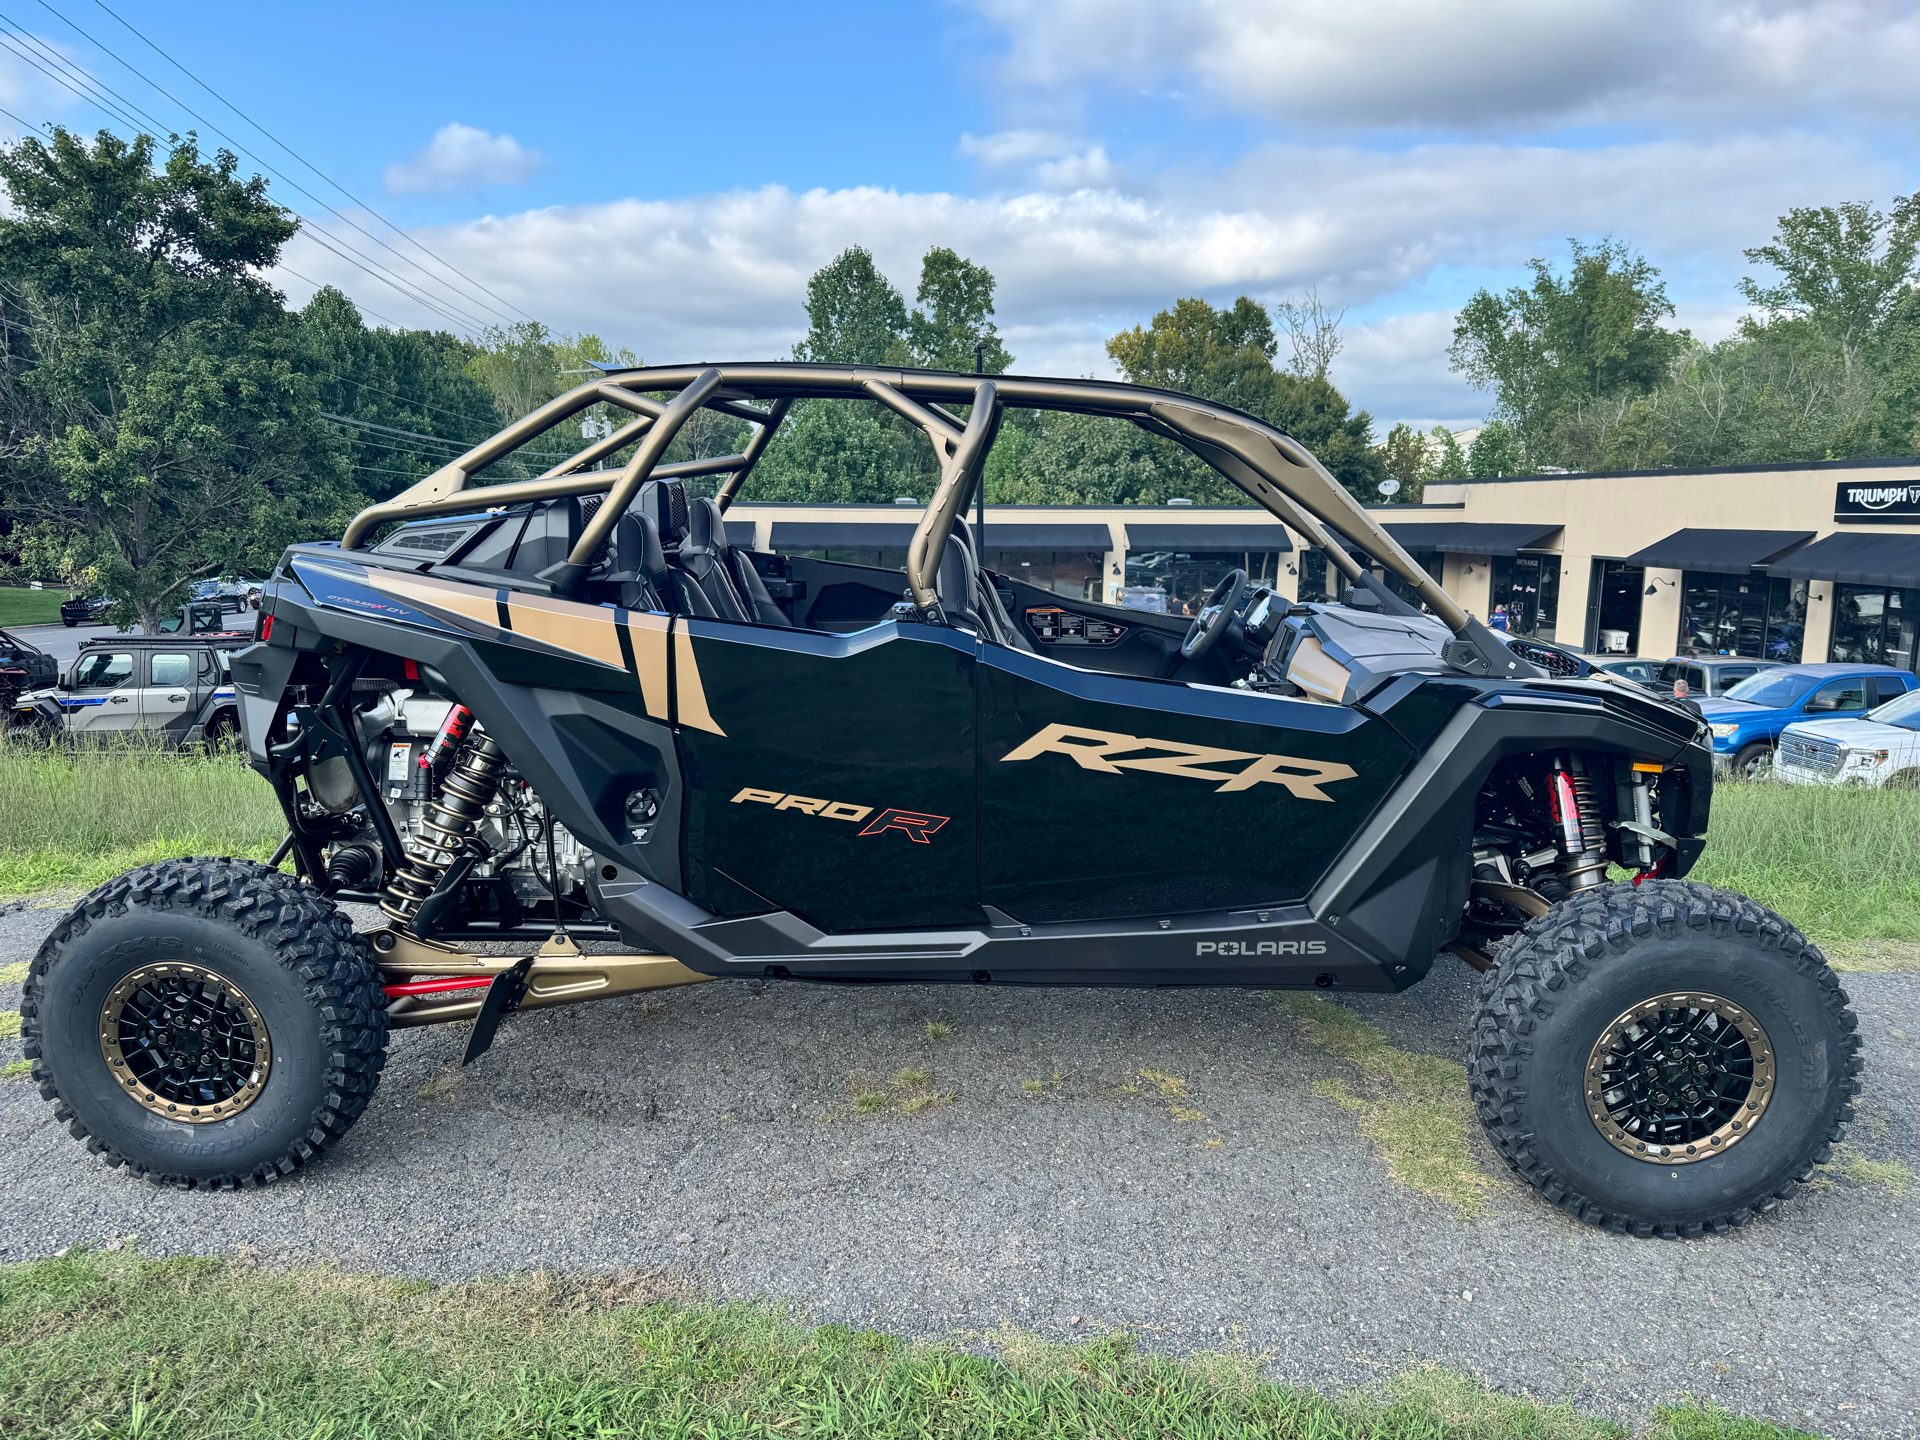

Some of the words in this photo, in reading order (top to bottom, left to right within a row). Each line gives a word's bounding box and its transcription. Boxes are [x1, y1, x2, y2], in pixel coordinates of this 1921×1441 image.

[1847, 488, 1908, 510] TRIUMPH
[1516, 558, 1539, 567] ENTRANCE
[326, 594, 389, 609] DYNAMIX
[999, 722, 1359, 803] RZR
[729, 787, 875, 823] PRO
[858, 808, 951, 844] R
[1196, 940, 1327, 956] POLARIS
[160, 1140, 215, 1156] FURY
